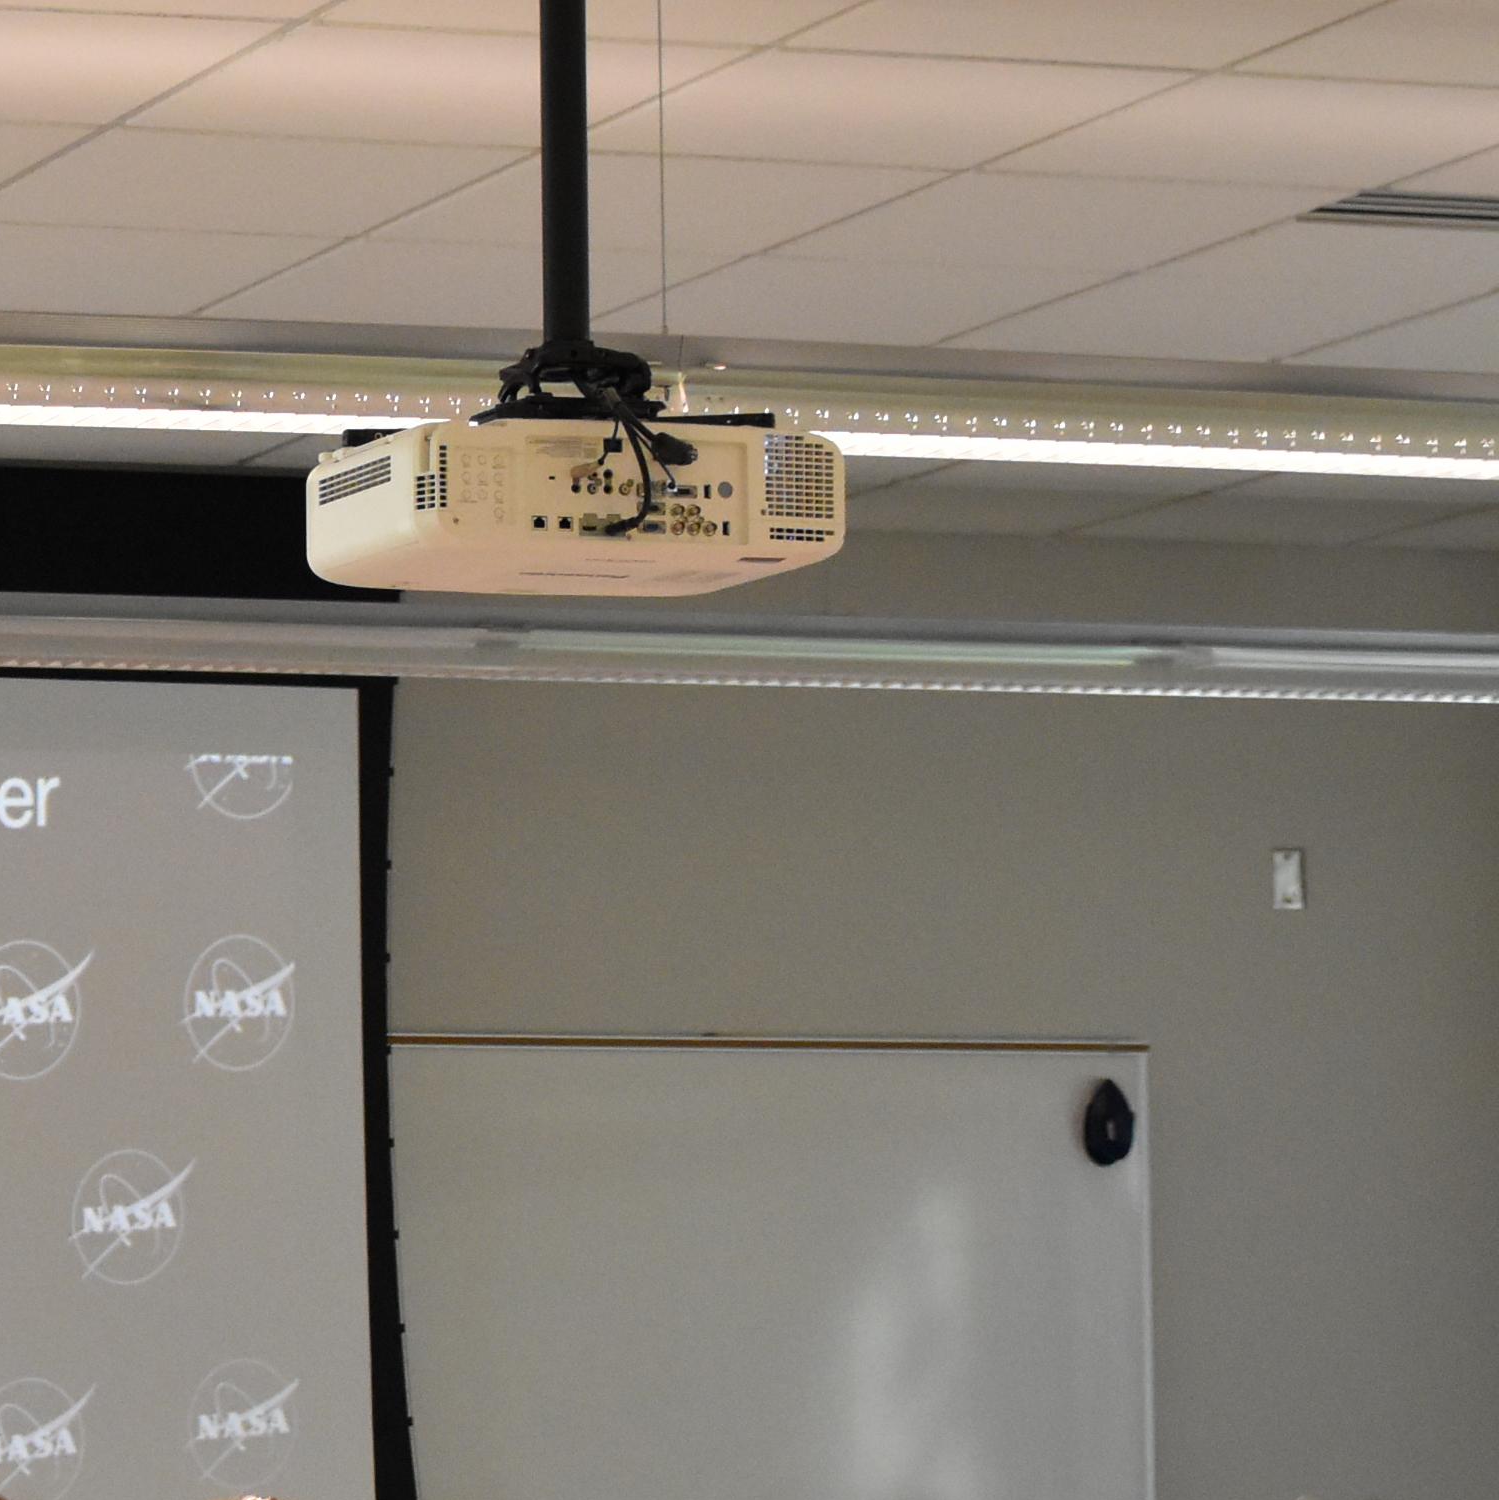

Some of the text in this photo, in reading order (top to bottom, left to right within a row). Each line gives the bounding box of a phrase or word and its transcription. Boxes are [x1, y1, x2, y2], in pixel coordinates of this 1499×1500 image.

[194, 990, 287, 1018] NASA
[83, 1200, 177, 1234] NASA
[199, 1407, 290, 1440] NASA
